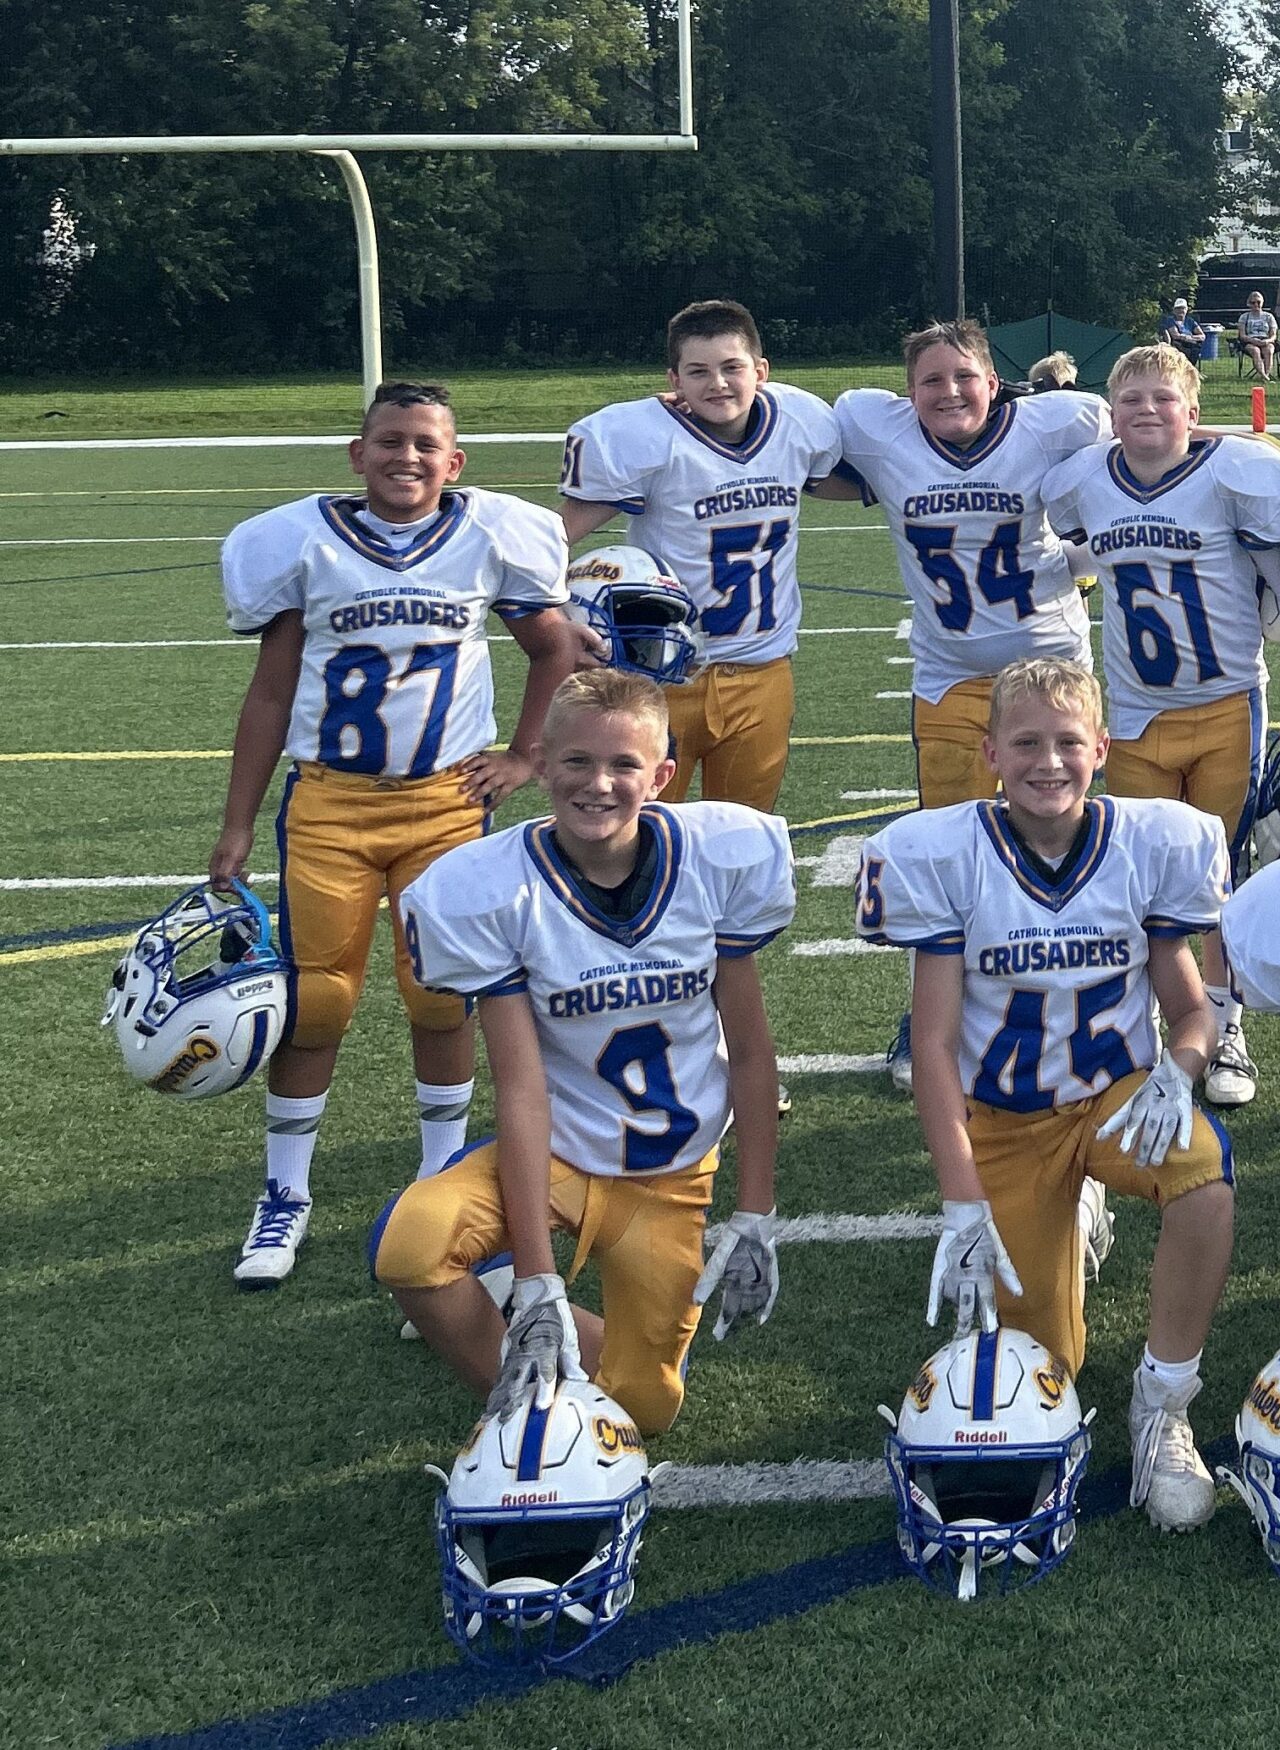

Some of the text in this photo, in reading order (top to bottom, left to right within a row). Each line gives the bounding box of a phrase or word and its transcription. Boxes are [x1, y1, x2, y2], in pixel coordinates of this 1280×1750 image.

[715, 475, 779, 492] CATHOLIC MEMORIAL
[927, 481, 1000, 492] CATHOLIC MEMORIAL
[694, 486, 798, 520] CRUSADERS
[904, 491, 1024, 517] CRUSADERS
[1110, 514, 1177, 527] CATHOLIC MEMORIAL
[1091, 527, 1202, 556] CRUSADERS
[701, 517, 792, 637] 51
[904, 518, 1038, 633] 54
[355, 586, 447, 600] CATHOLIC MEMORIAL
[329, 600, 470, 633] CRUSADERS
[1112, 559, 1226, 687] 61
[318, 640, 461, 779] 87
[1008, 926, 1105, 941] CATHOLIC MEMORIAL
[579, 958, 684, 981] CATHOLIC MEMORIAL
[979, 938, 1131, 976] CRUSADERS
[237, 979, 274, 998] Riddell
[548, 968, 709, 1018] CRUSADERS
[971, 972, 1136, 1114] 45
[596, 1019, 699, 1172] 9
[954, 1430, 1007, 1443] Riddell
[502, 1491, 558, 1507] Riddell
